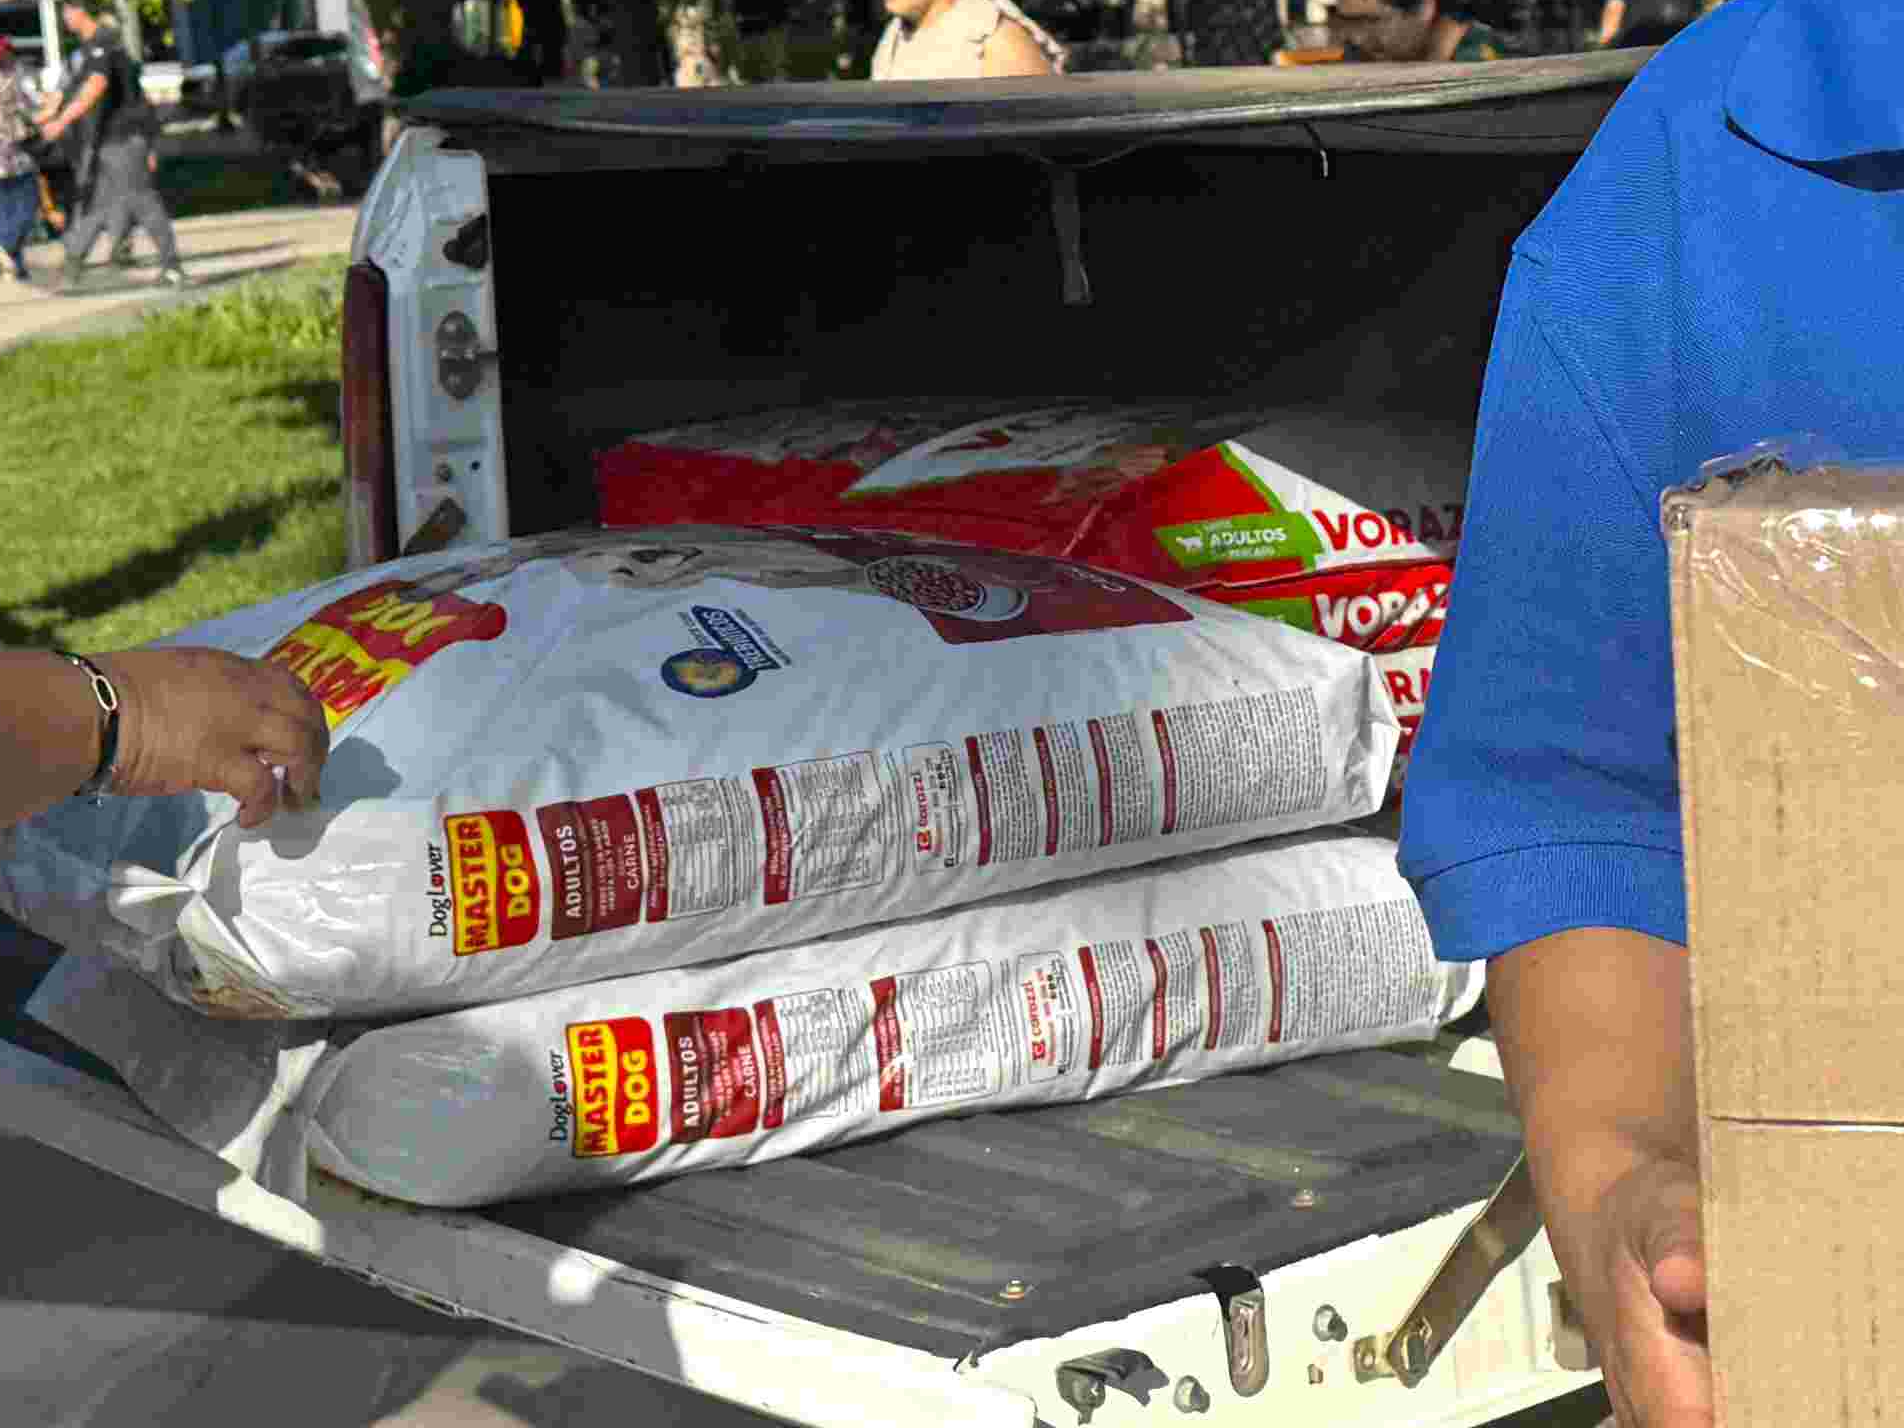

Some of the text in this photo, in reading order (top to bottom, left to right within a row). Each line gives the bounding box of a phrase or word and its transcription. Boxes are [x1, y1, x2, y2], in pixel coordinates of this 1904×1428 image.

[457, 818, 489, 948] MASTER
[498, 844, 531, 918] DOG
[556, 824, 583, 919] ADULTOS
[624, 832, 640, 890] CARNE
[578, 1025, 609, 1152] MASTER
[622, 1049, 651, 1125] DOG
[678, 1035, 700, 1128] ADULTOS
[736, 1043, 757, 1099] CARNE
